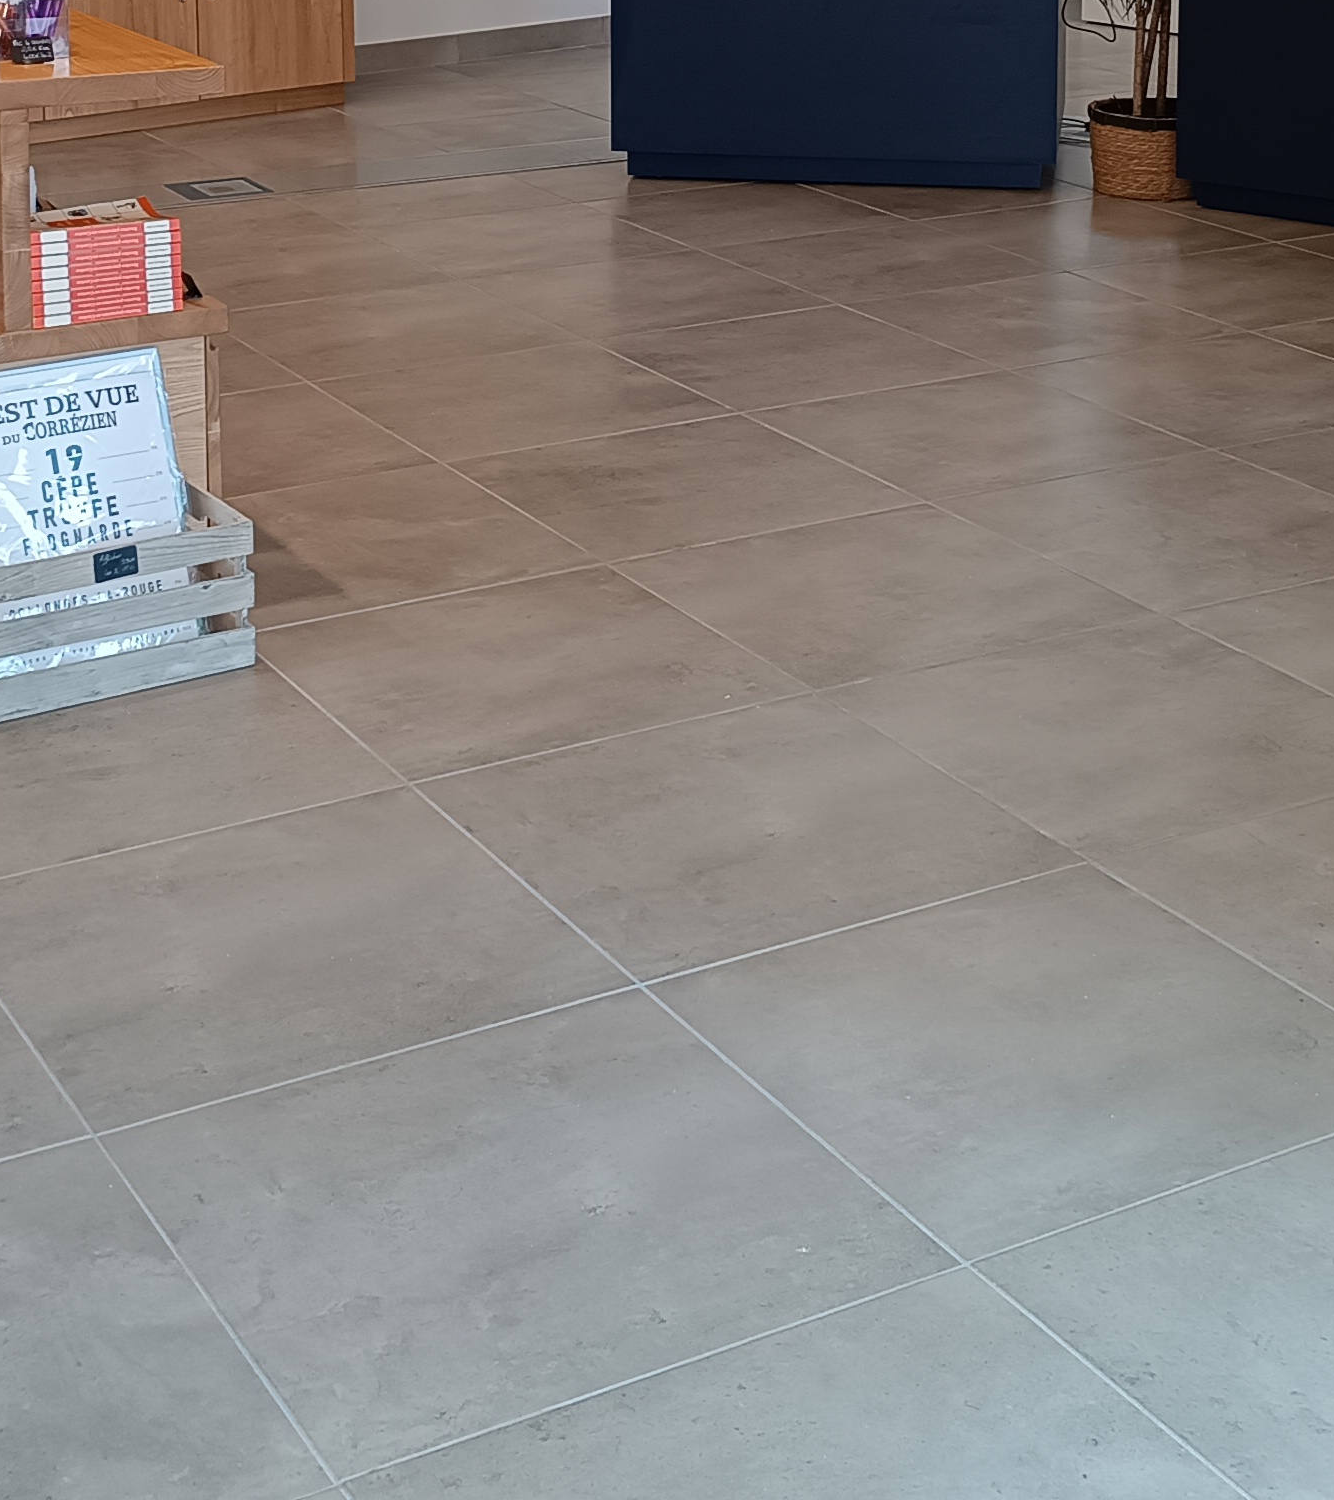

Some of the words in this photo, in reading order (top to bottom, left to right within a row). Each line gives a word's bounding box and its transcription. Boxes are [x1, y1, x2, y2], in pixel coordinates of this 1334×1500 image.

[44, 393, 81, 416] DE
[85, 384, 140, 409] VUE
[2, 434, 21, 445] DU
[22, 410, 118, 441] CORRÉZIEN
[45, 444, 83, 474] 19
